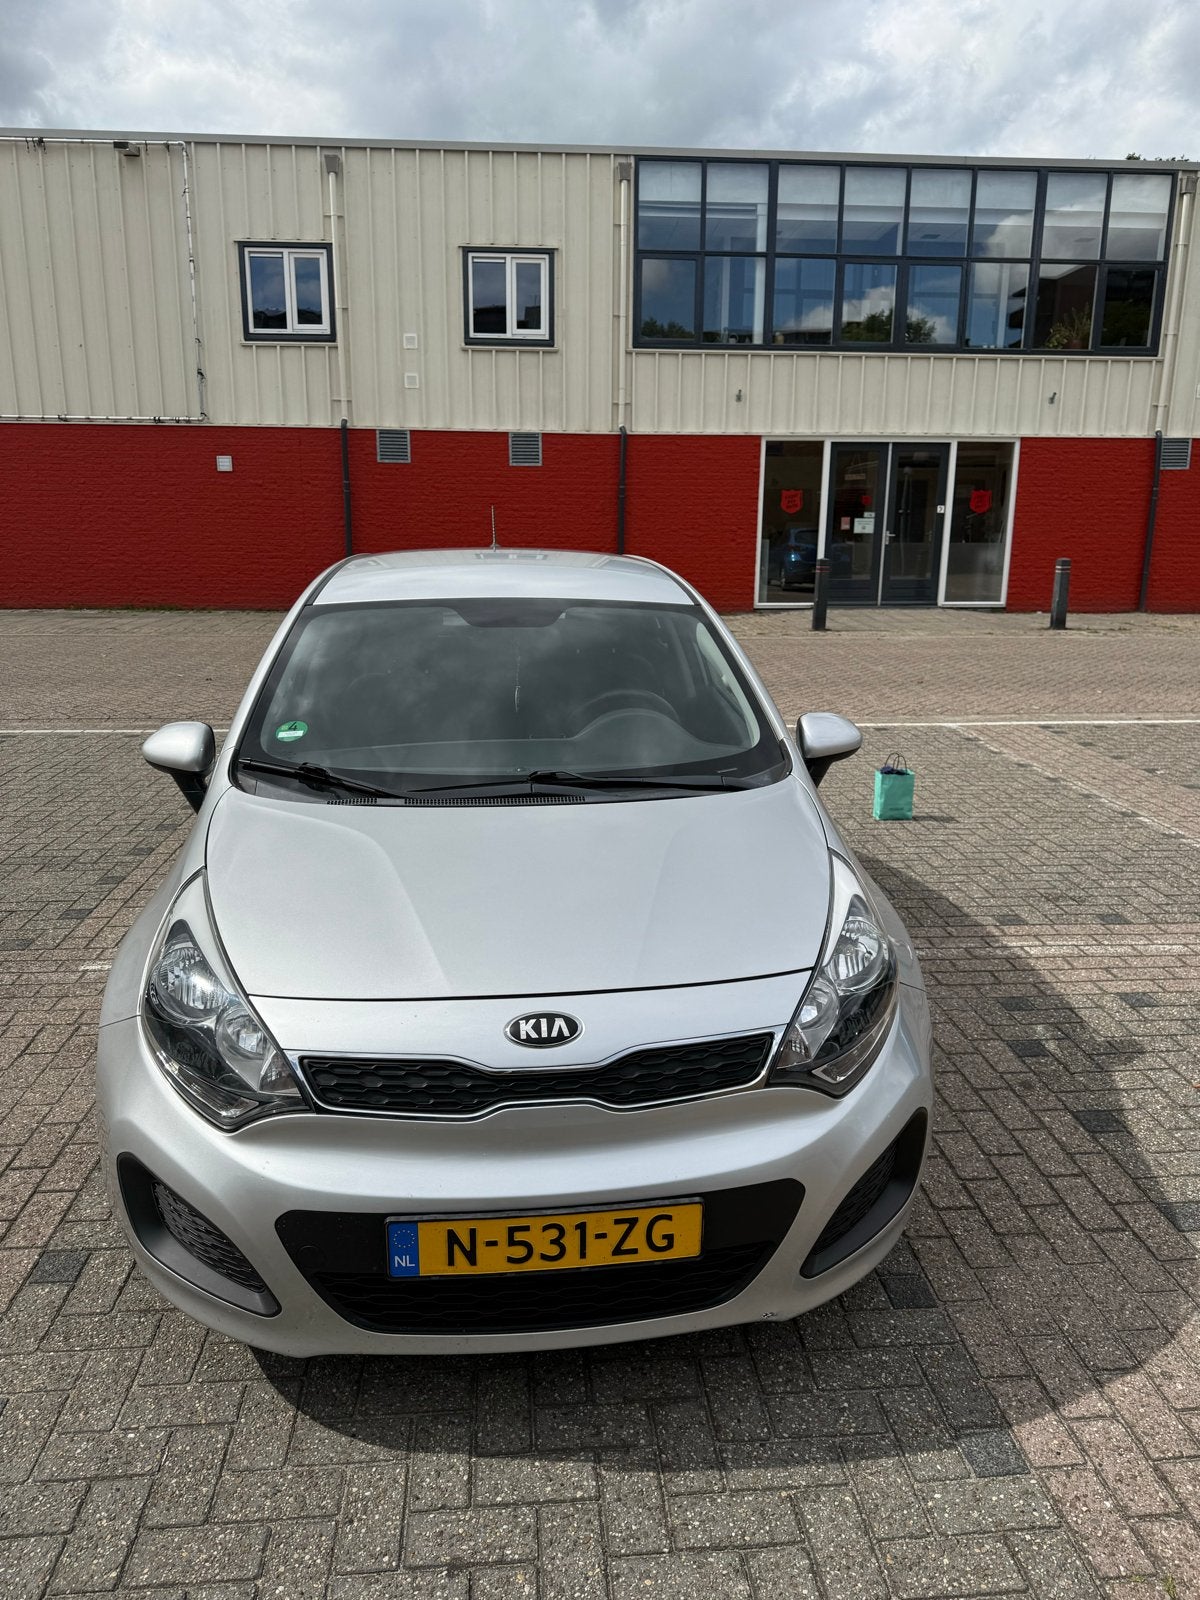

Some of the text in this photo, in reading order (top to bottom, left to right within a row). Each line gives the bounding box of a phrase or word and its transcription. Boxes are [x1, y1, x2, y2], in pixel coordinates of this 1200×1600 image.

[288, 721, 298, 731] 4
[518, 1017, 571, 1040] KIA
[446, 1214, 675, 1267] N-531-ZG
[394, 1255, 416, 1268] NL
